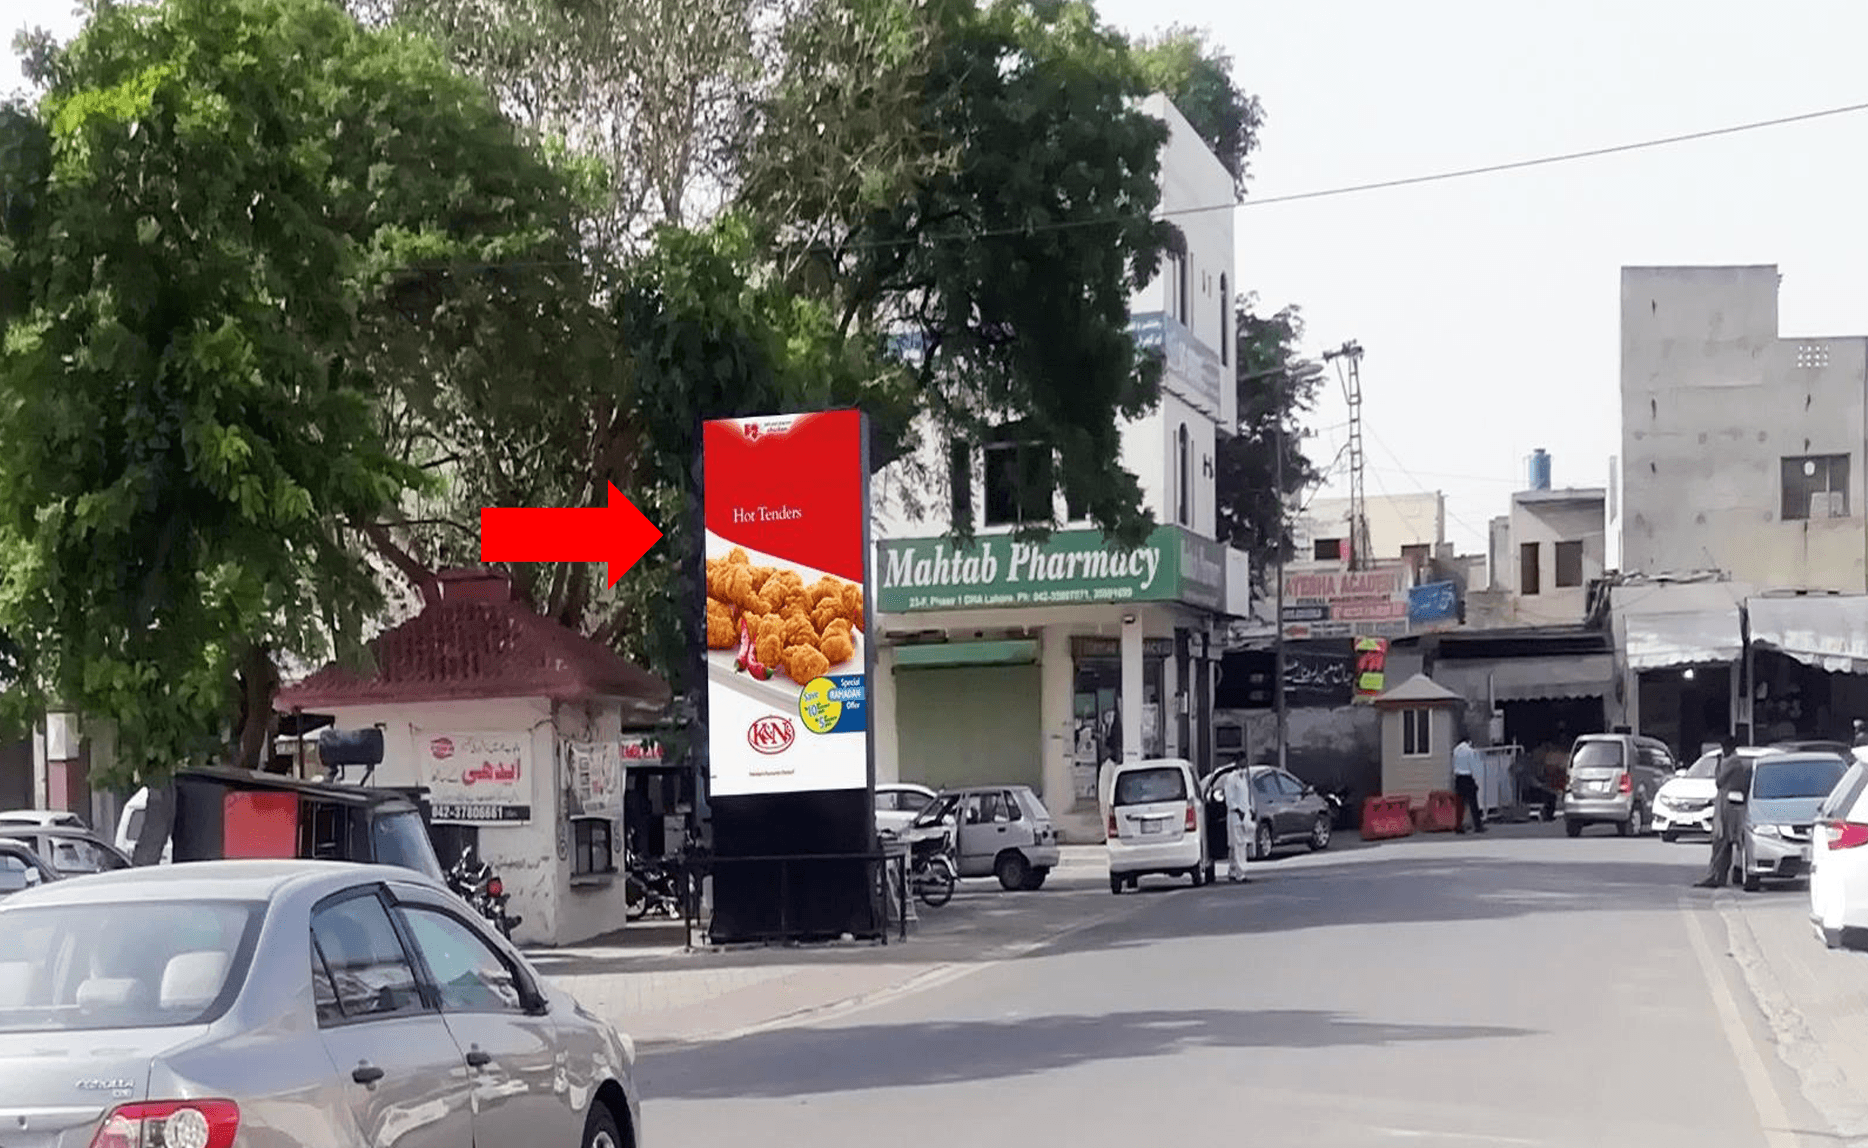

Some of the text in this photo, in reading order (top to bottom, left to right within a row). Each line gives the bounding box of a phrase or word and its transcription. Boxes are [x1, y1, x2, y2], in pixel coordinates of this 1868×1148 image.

[733, 504, 802, 523] Hot Tenders
[883, 543, 997, 588] Mahtab
[1006, 541, 1160, 590] Pharmacy
[841, 677, 860, 687] Special
[829, 688, 862, 699] RAMADAN
[846, 701, 861, 710] Offer
